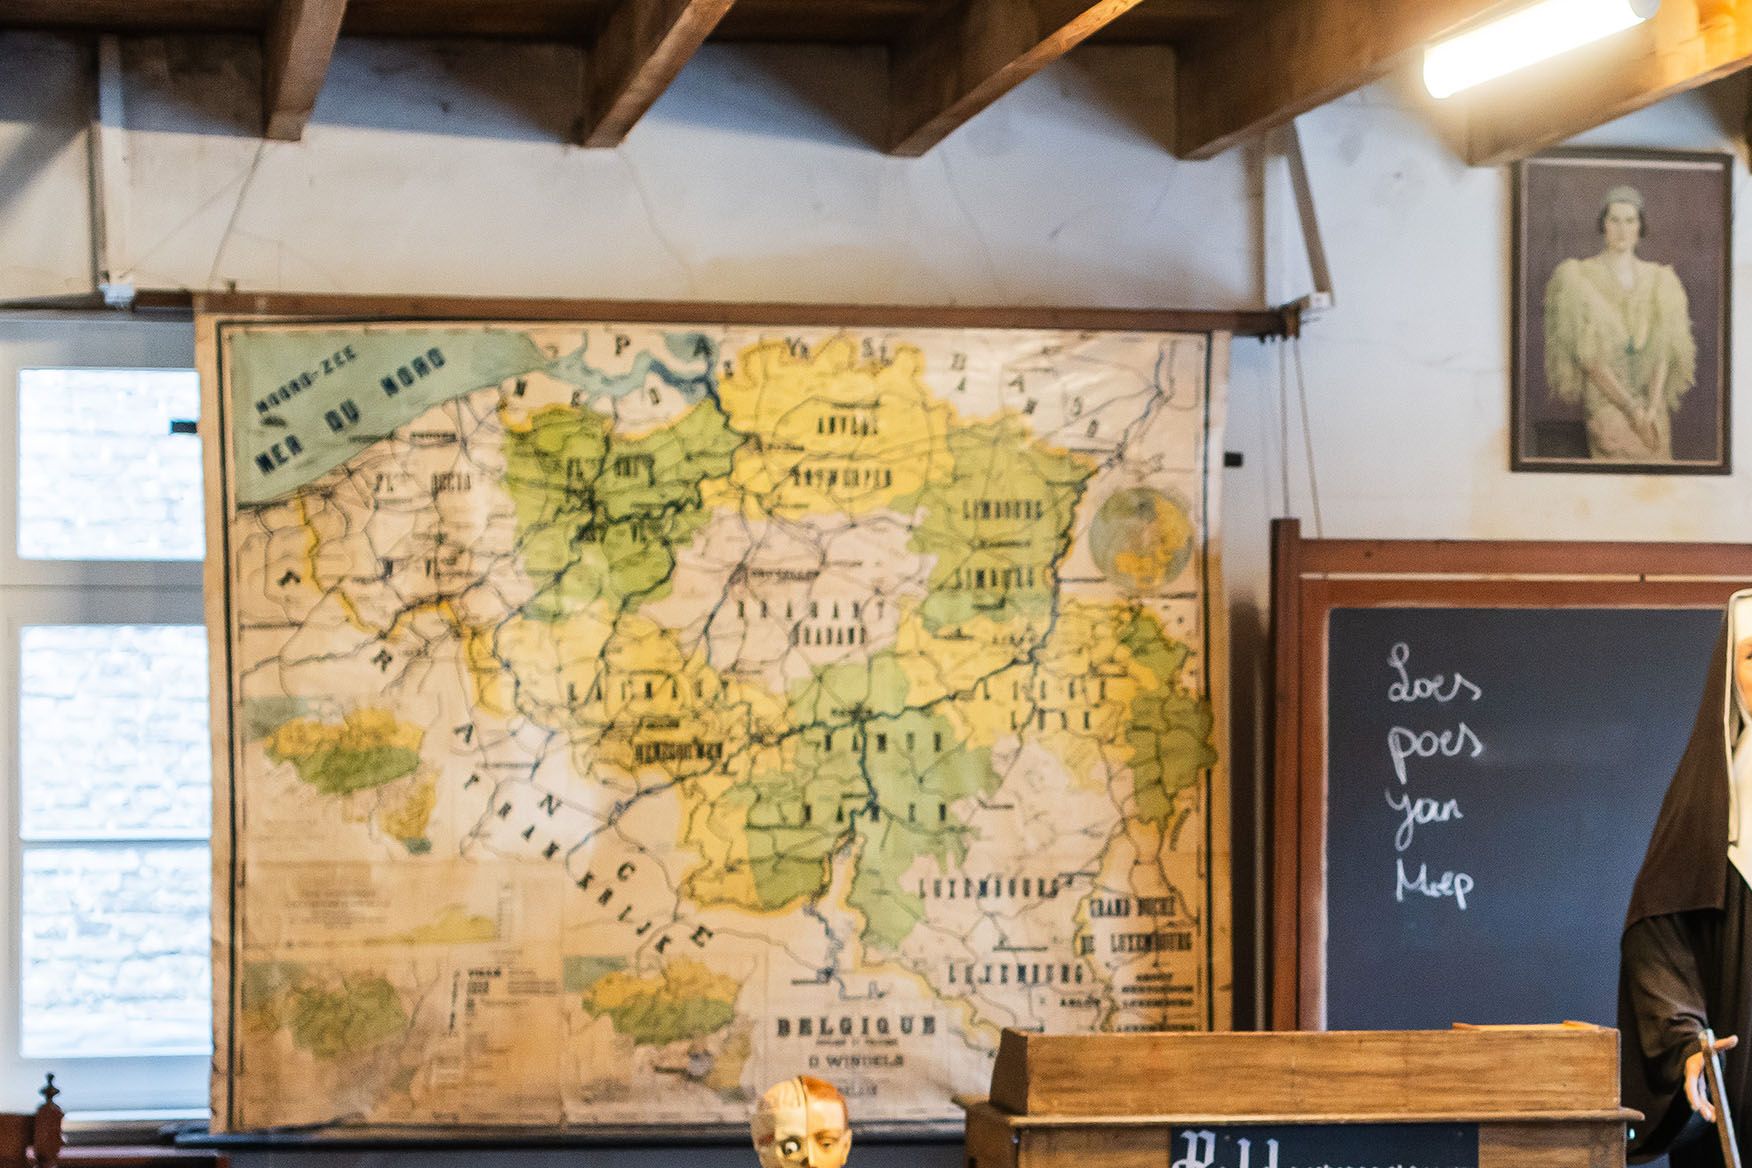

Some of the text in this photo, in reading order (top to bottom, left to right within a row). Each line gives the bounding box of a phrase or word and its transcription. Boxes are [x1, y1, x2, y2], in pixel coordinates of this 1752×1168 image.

[255, 347, 446, 476] MER DU NORD
[777, 1015, 936, 1038] BELGIQUE
